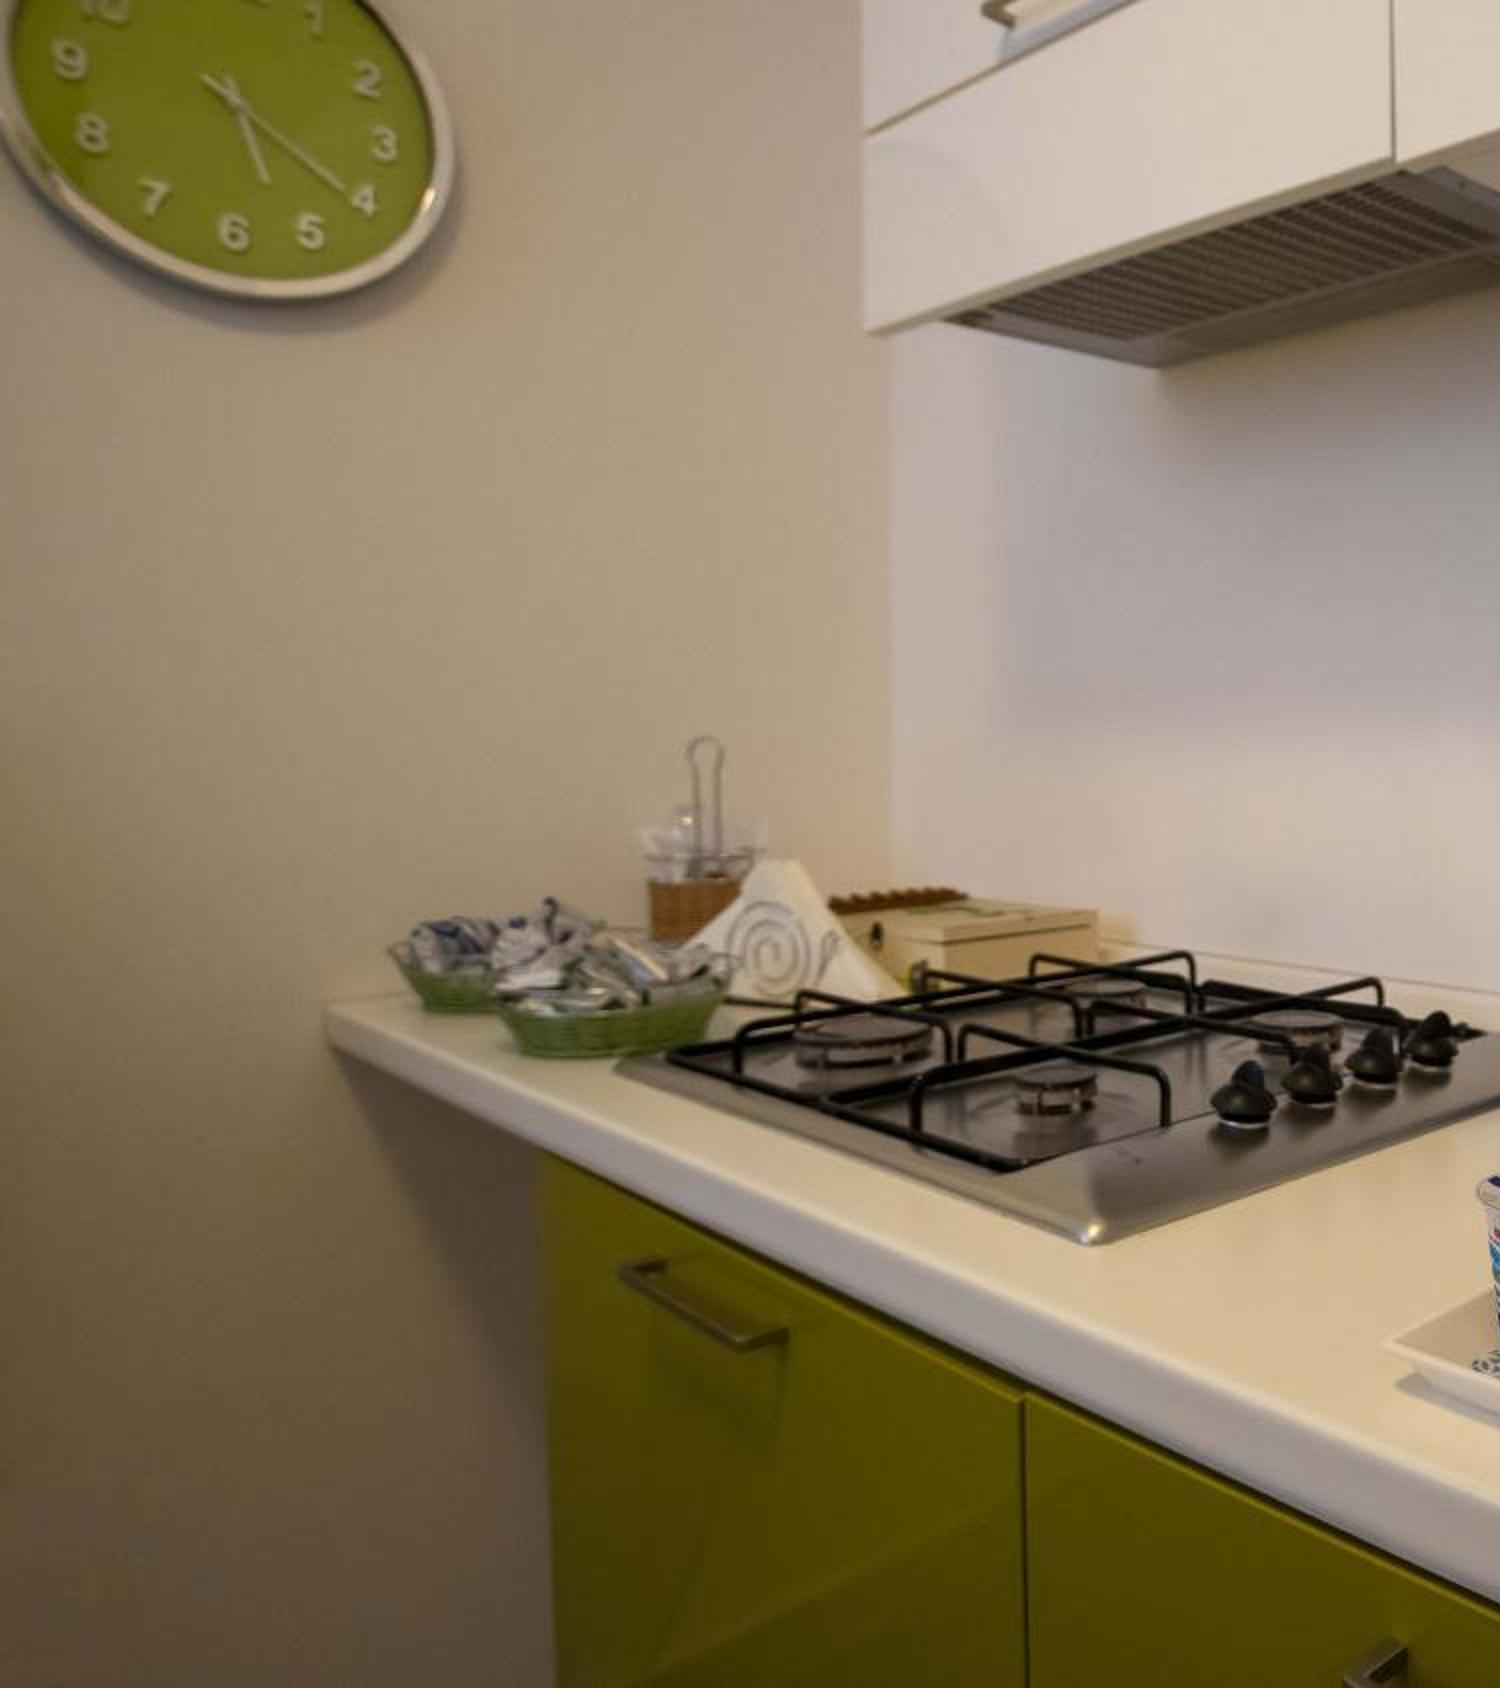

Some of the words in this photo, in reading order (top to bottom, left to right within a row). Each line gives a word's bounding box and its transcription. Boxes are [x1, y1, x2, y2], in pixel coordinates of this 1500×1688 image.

[52, 39, 87, 80] 9
[353, 61, 382, 98] 2
[76, 113, 110, 152] 8
[371, 126, 398, 160] 3
[138, 178, 171, 216] 7
[351, 184, 378, 216] 4
[218, 212, 250, 250] 6
[296, 212, 325, 250] 5
